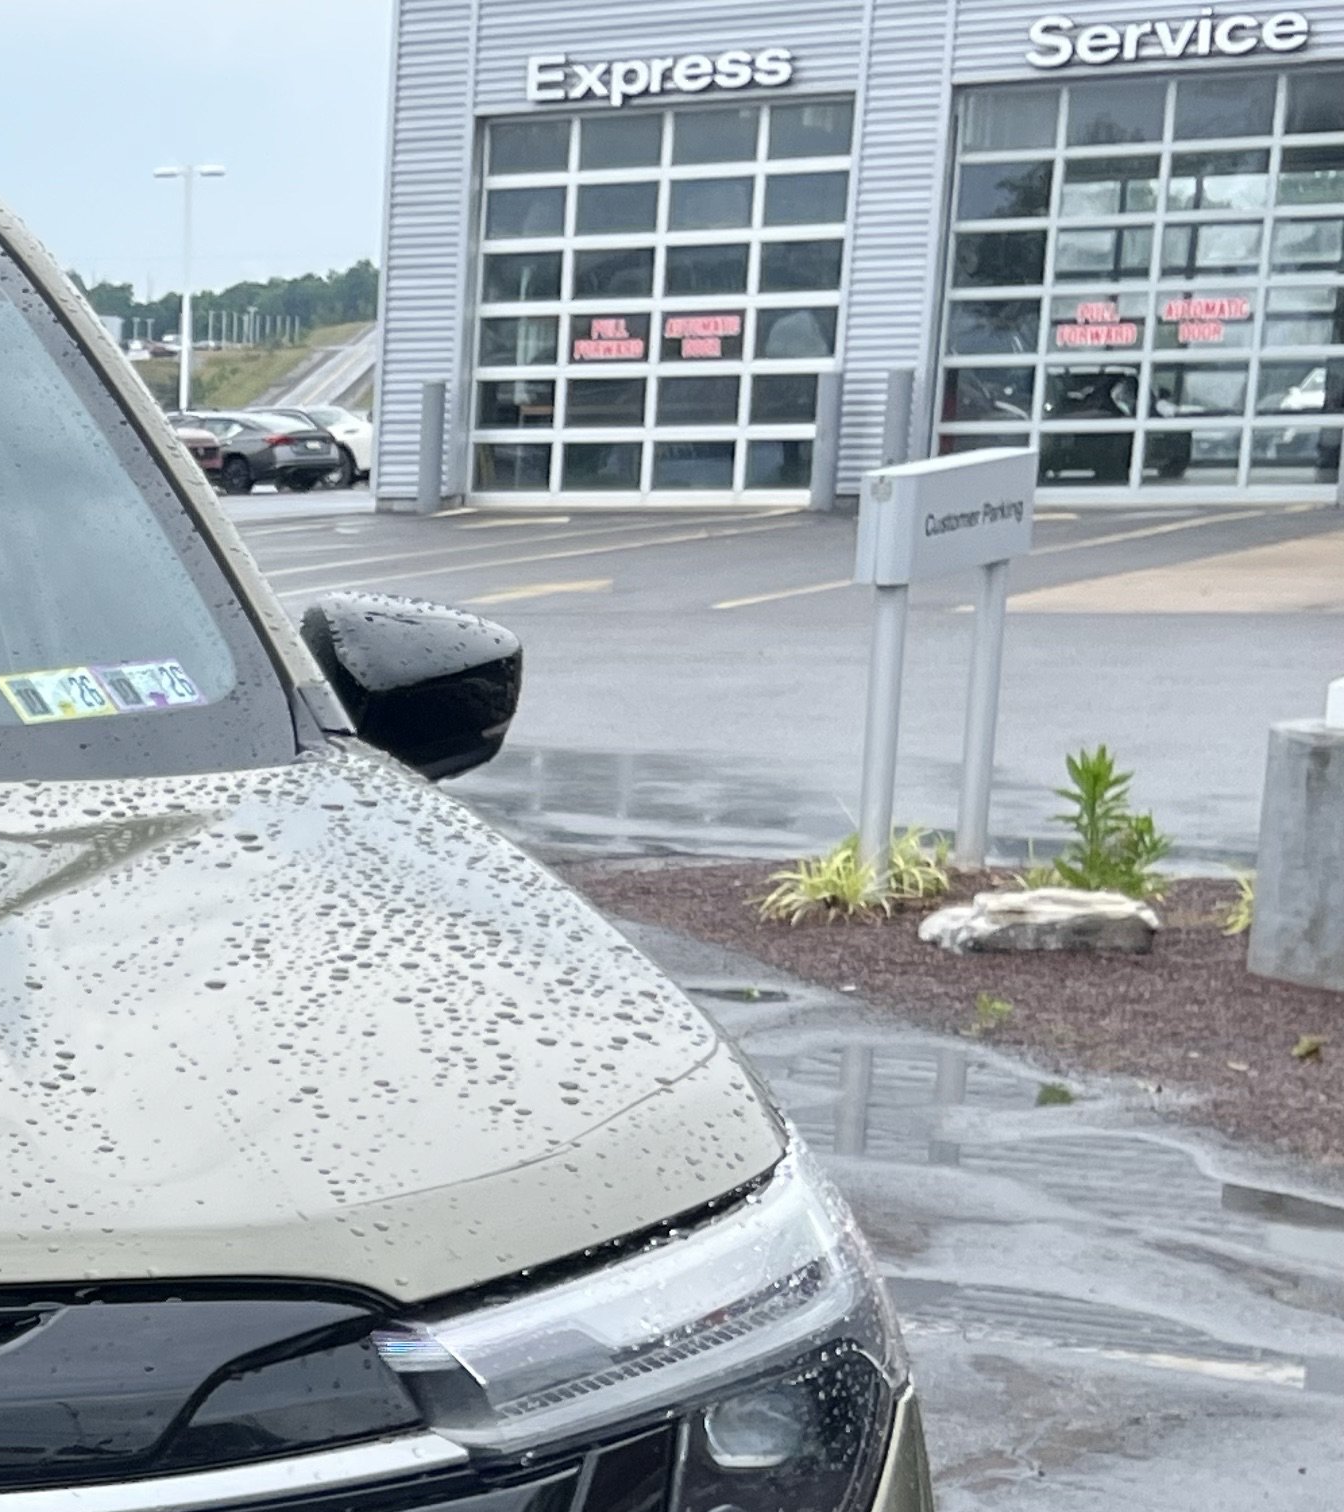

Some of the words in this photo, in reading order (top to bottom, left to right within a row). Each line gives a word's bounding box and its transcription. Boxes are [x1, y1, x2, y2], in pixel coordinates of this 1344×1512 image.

[1025, 7, 1309, 68] Service
[526, 48, 793, 107] Express
[1077, 302, 1120, 324] PULL
[1162, 297, 1250, 321] AUTOMATIC
[1056, 323, 1137, 347] FORWARD
[1178, 320, 1225, 343] DOOR
[925, 510, 981, 537] Customer
[983, 500, 1024, 524] Parking
[68, 675, 105, 708] 26
[158, 665, 196, 697] 26
